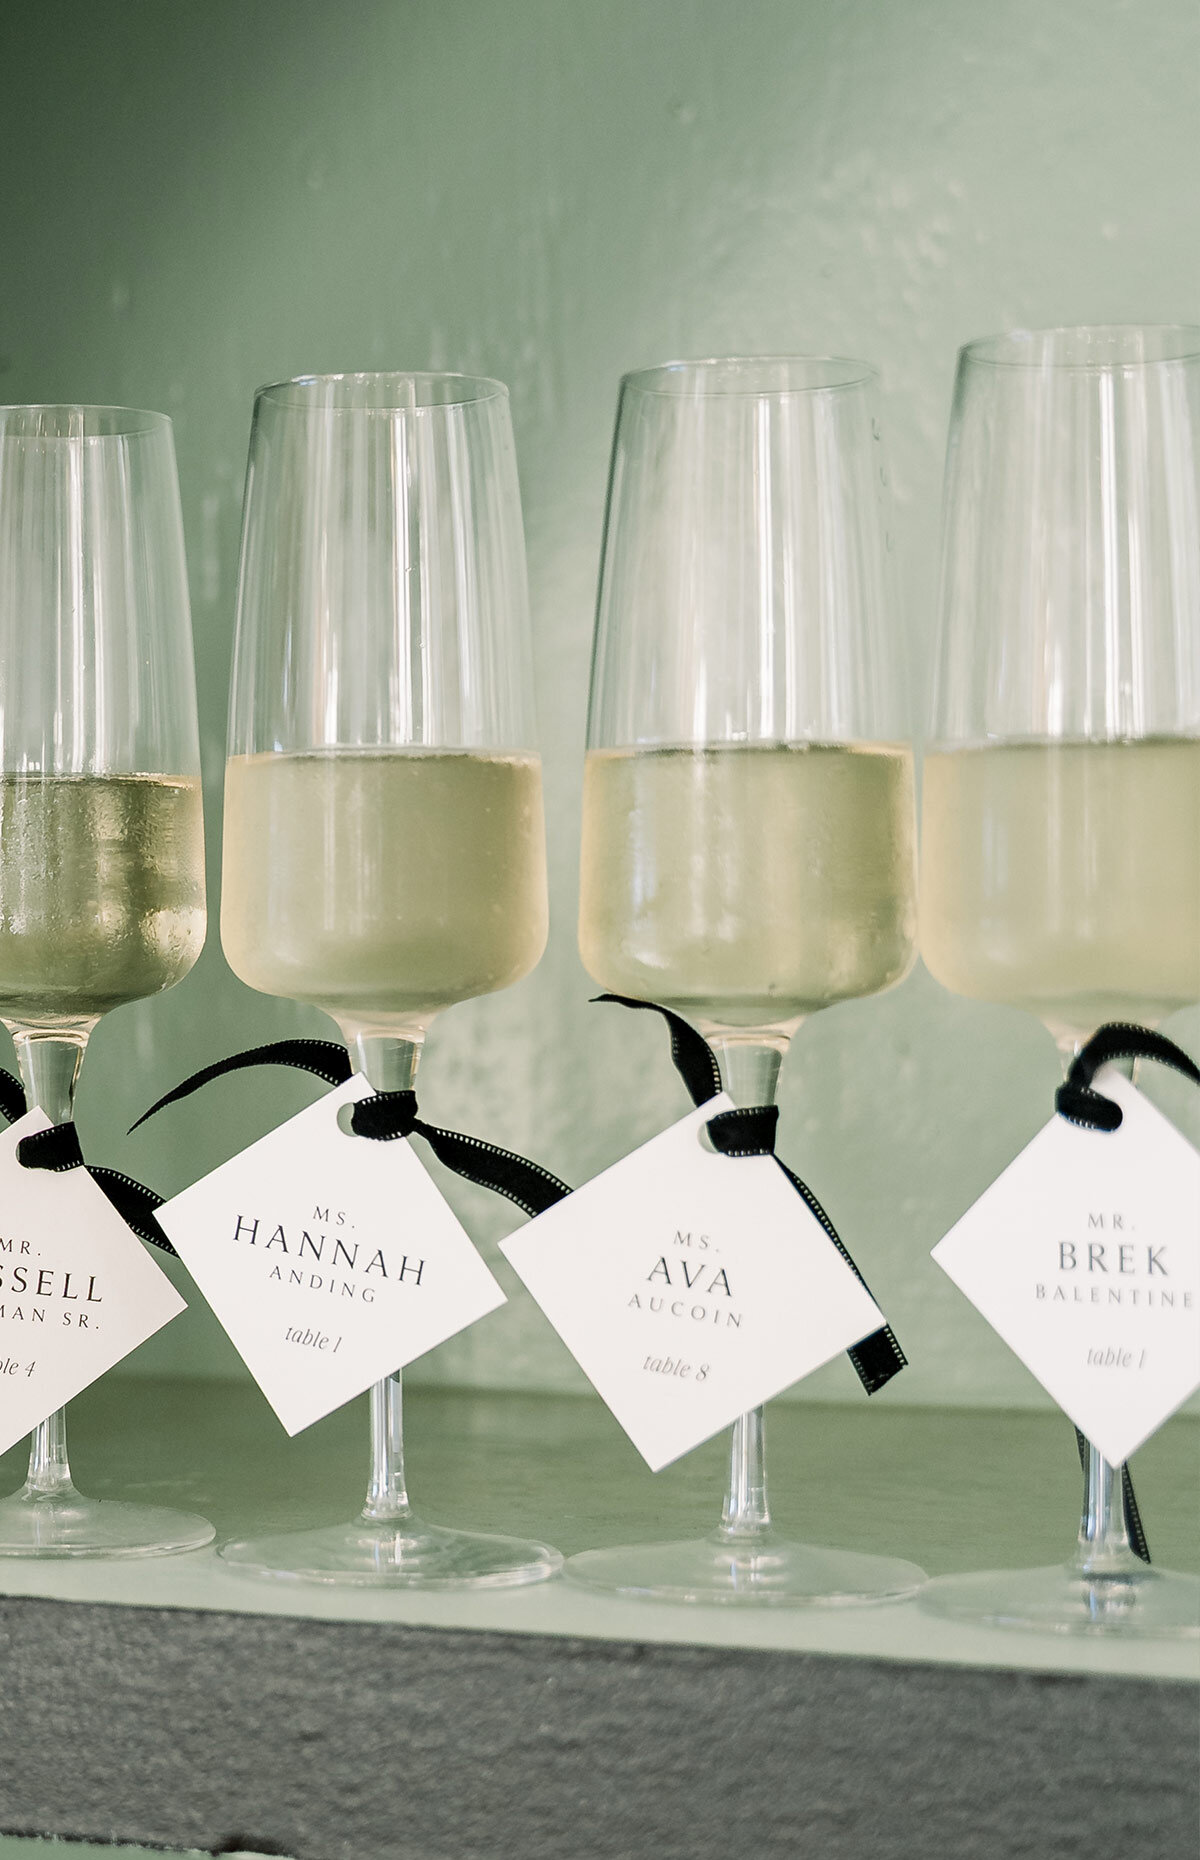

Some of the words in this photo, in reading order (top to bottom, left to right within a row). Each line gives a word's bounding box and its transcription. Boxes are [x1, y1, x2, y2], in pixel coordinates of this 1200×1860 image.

[313, 1206, 355, 1229] MS.
[1088, 1213, 1136, 1230] MR.
[233, 1214, 427, 1286] HANNAH
[674, 1230, 720, 1253] MS.
[1058, 1241, 1169, 1276] BREK
[269, 1265, 376, 1303] ANDING
[646, 1256, 733, 1297] AVA
[1035, 1283, 1193, 1309] BALENTINE
[62, 1311, 100, 1330] SR.
[628, 1293, 743, 1328] AUCOIN
[285, 1326, 330, 1350] table
[24, 1360, 36, 1378] 4
[643, 1355, 691, 1378] table
[695, 1363, 710, 1382] 8
[1086, 1346, 1132, 1368] table
